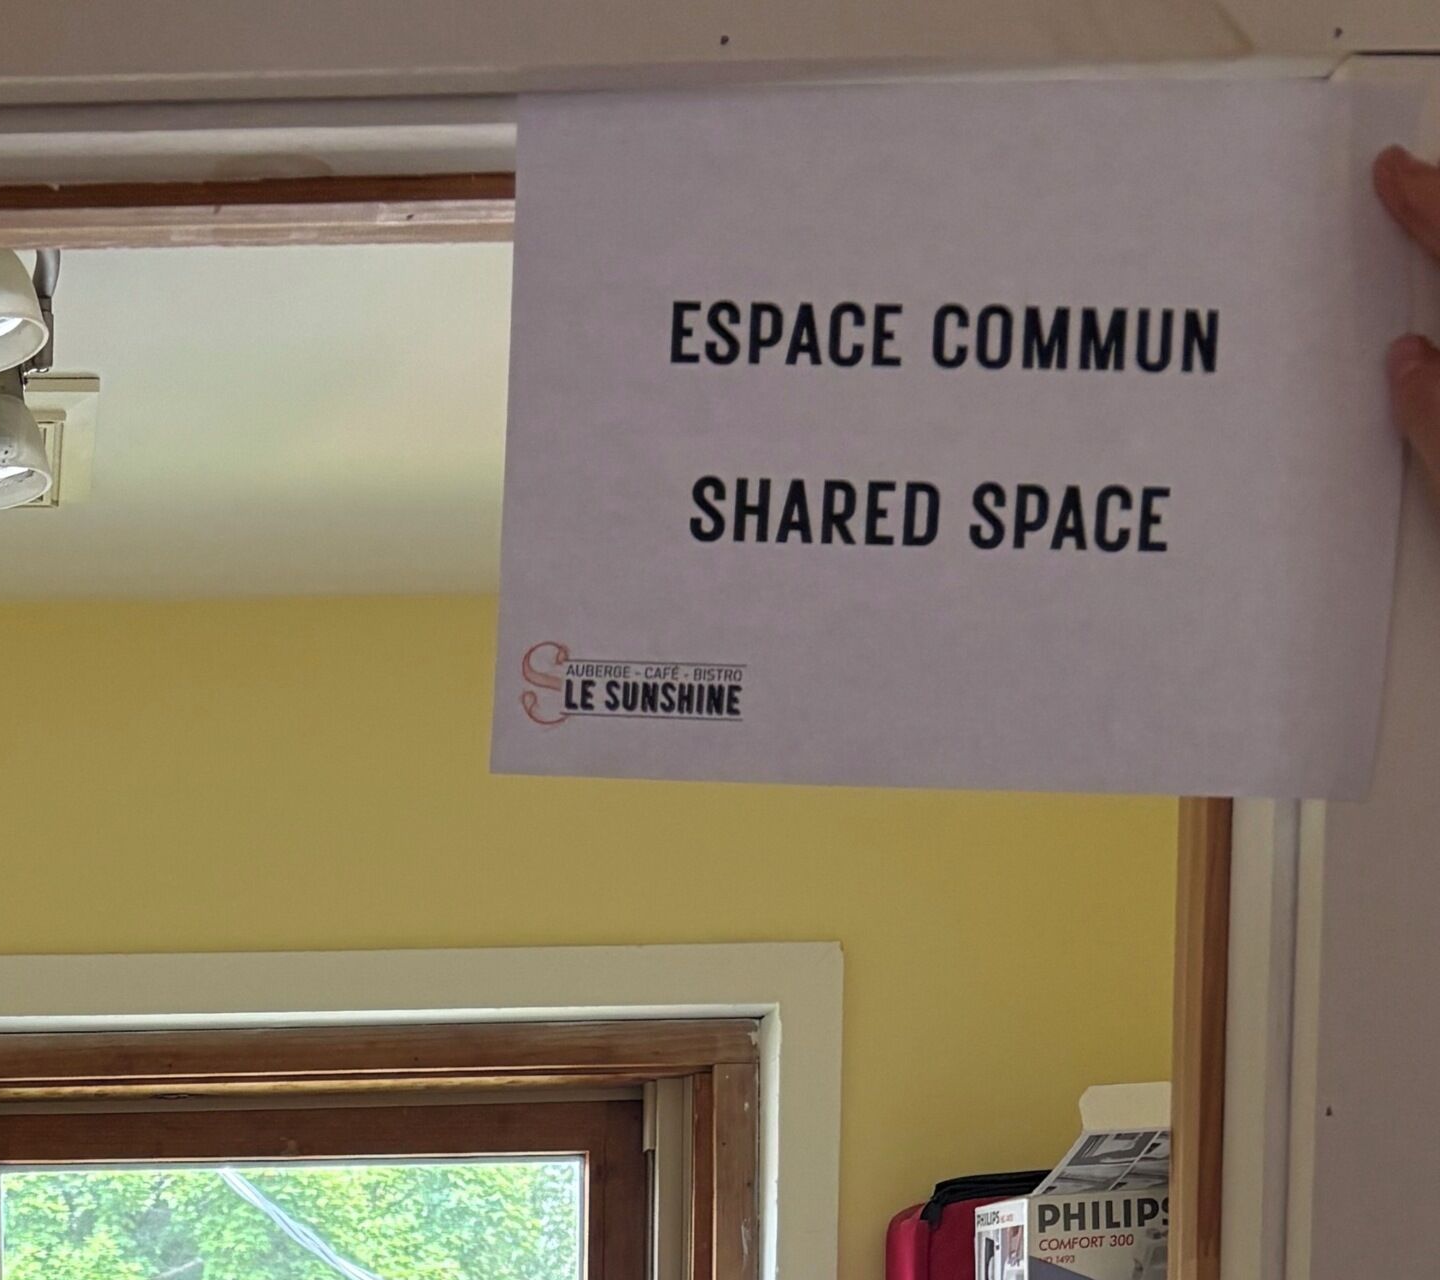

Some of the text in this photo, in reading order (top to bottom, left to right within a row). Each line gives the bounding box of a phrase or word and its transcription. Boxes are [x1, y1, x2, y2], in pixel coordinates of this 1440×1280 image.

[669, 299, 1220, 374] ESPACE COMMUN
[688, 475, 1172, 553] SHARED SPACE
[566, 664, 631, 679] AUBERGE
[644, 664, 679, 680] CAFÉ
[693, 667, 743, 683] BISTRO
[564, 679, 743, 716] LE SUNSHINE
[1038, 1234, 1134, 1251] COMFORT 300
